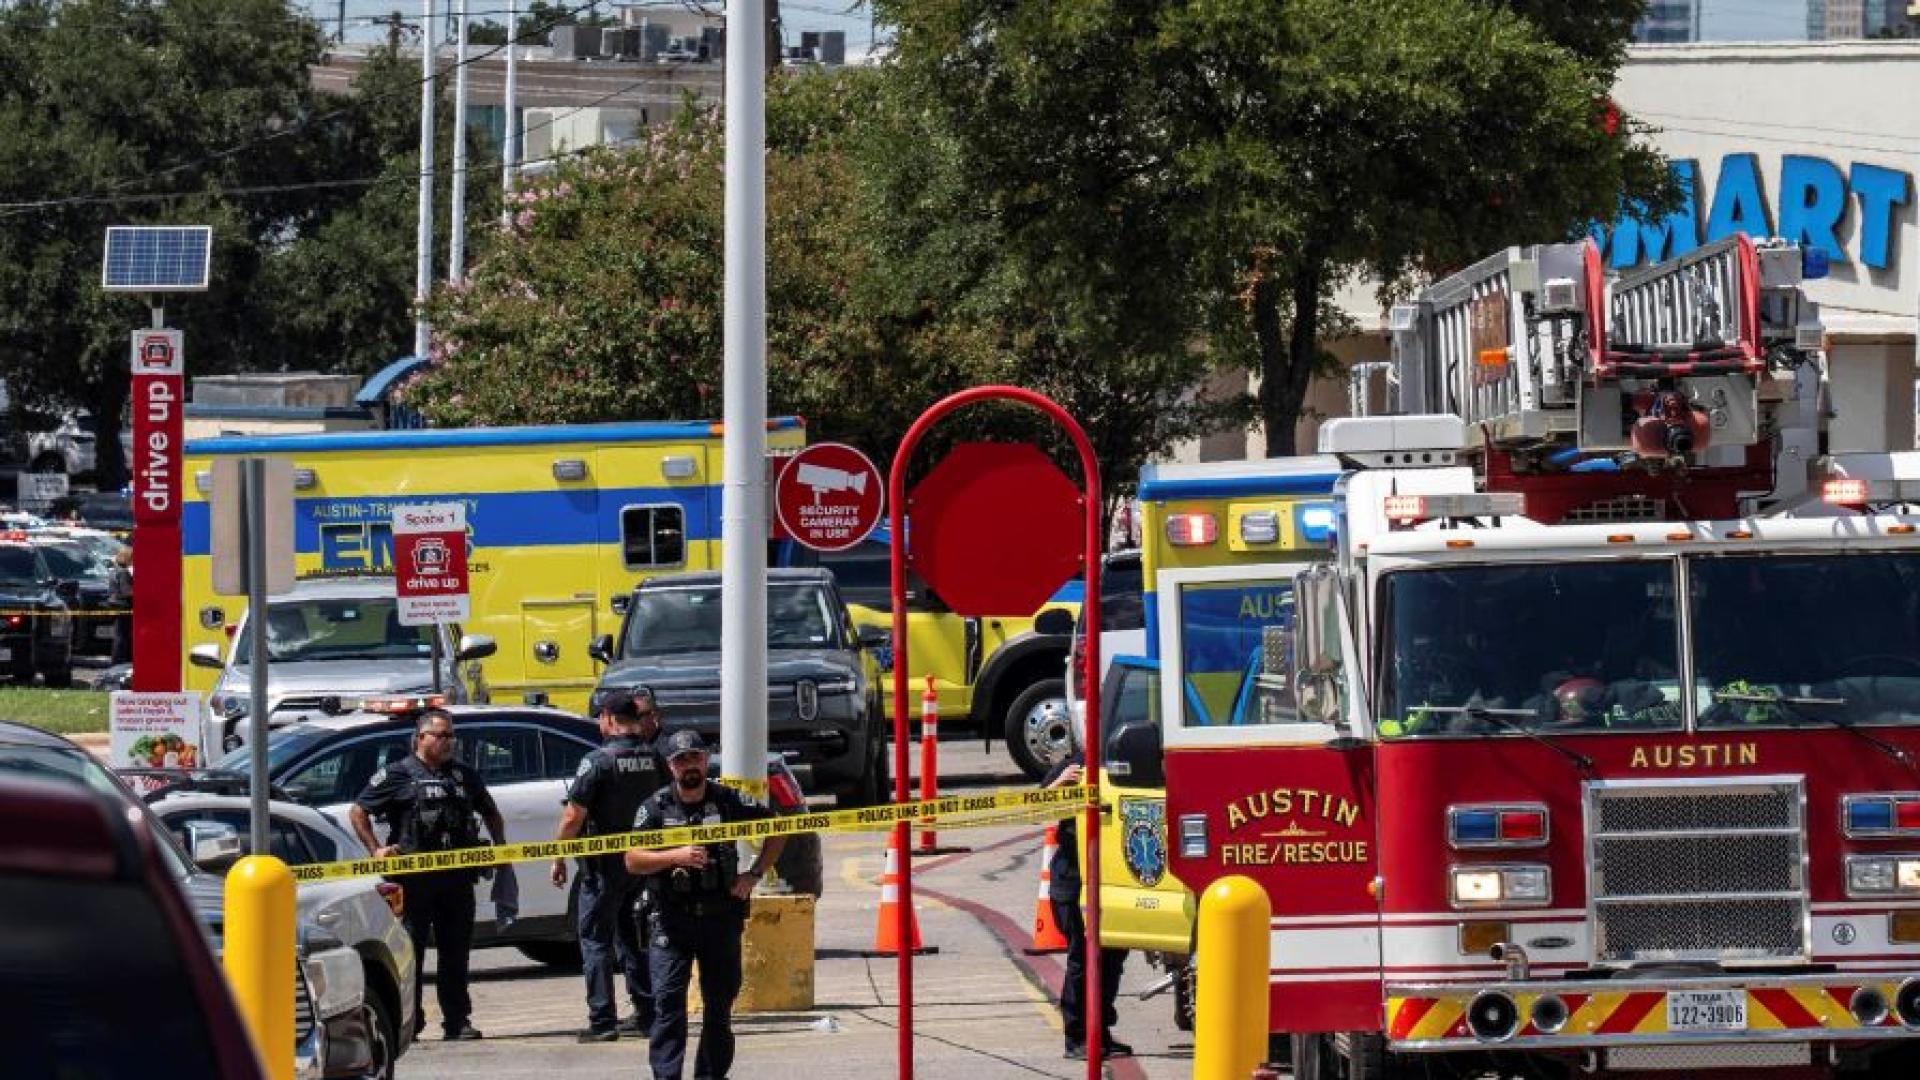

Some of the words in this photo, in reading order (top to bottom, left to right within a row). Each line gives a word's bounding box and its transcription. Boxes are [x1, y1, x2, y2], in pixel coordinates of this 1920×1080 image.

[1590, 152, 1907, 269] MART
[147, 380, 175, 422] up
[141, 430, 170, 512] drive
[404, 512, 444, 526] Space
[449, 511, 456, 523] 1
[799, 505, 860, 515] SECURITY
[800, 516, 860, 528] CAMERAS
[809, 528, 824, 539] IN
[826, 528, 851, 539] USE
[406, 576, 440, 590] drive
[441, 578, 460, 590] up
[616, 757, 657, 772] POLICE
[1630, 742, 1758, 769] AUSTIN
[1023, 789, 1059, 804] POLICE
[1062, 786, 1084, 800] LINE
[856, 807, 894, 823] POLICE
[896, 804, 918, 819] LINE
[920, 801, 936, 816] DO
[938, 799, 959, 814] NOT
[963, 796, 997, 811] CROSS
[1227, 788, 1361, 830] AUSTIN
[691, 826, 727, 841] POLICE
[730, 823, 752, 838] LINE
[756, 821, 770, 834] DO
[773, 819, 793, 833] NOT
[796, 814, 831, 830] CROSS
[522, 843, 559, 858] POLICE
[562, 841, 584, 855] LINE
[588, 839, 603, 852] DO
[606, 835, 625, 850] NOT
[629, 832, 664, 847] CROSS
[1221, 840, 1369, 865] FIRE/RESCUE
[352, 859, 389, 875] POLICE
[391, 856, 415, 871] LINE
[417, 854, 433, 868] DO
[435, 852, 456, 867] NOT
[459, 848, 496, 865] CROSS
[1690, 993, 1722, 1002] TEXAS
